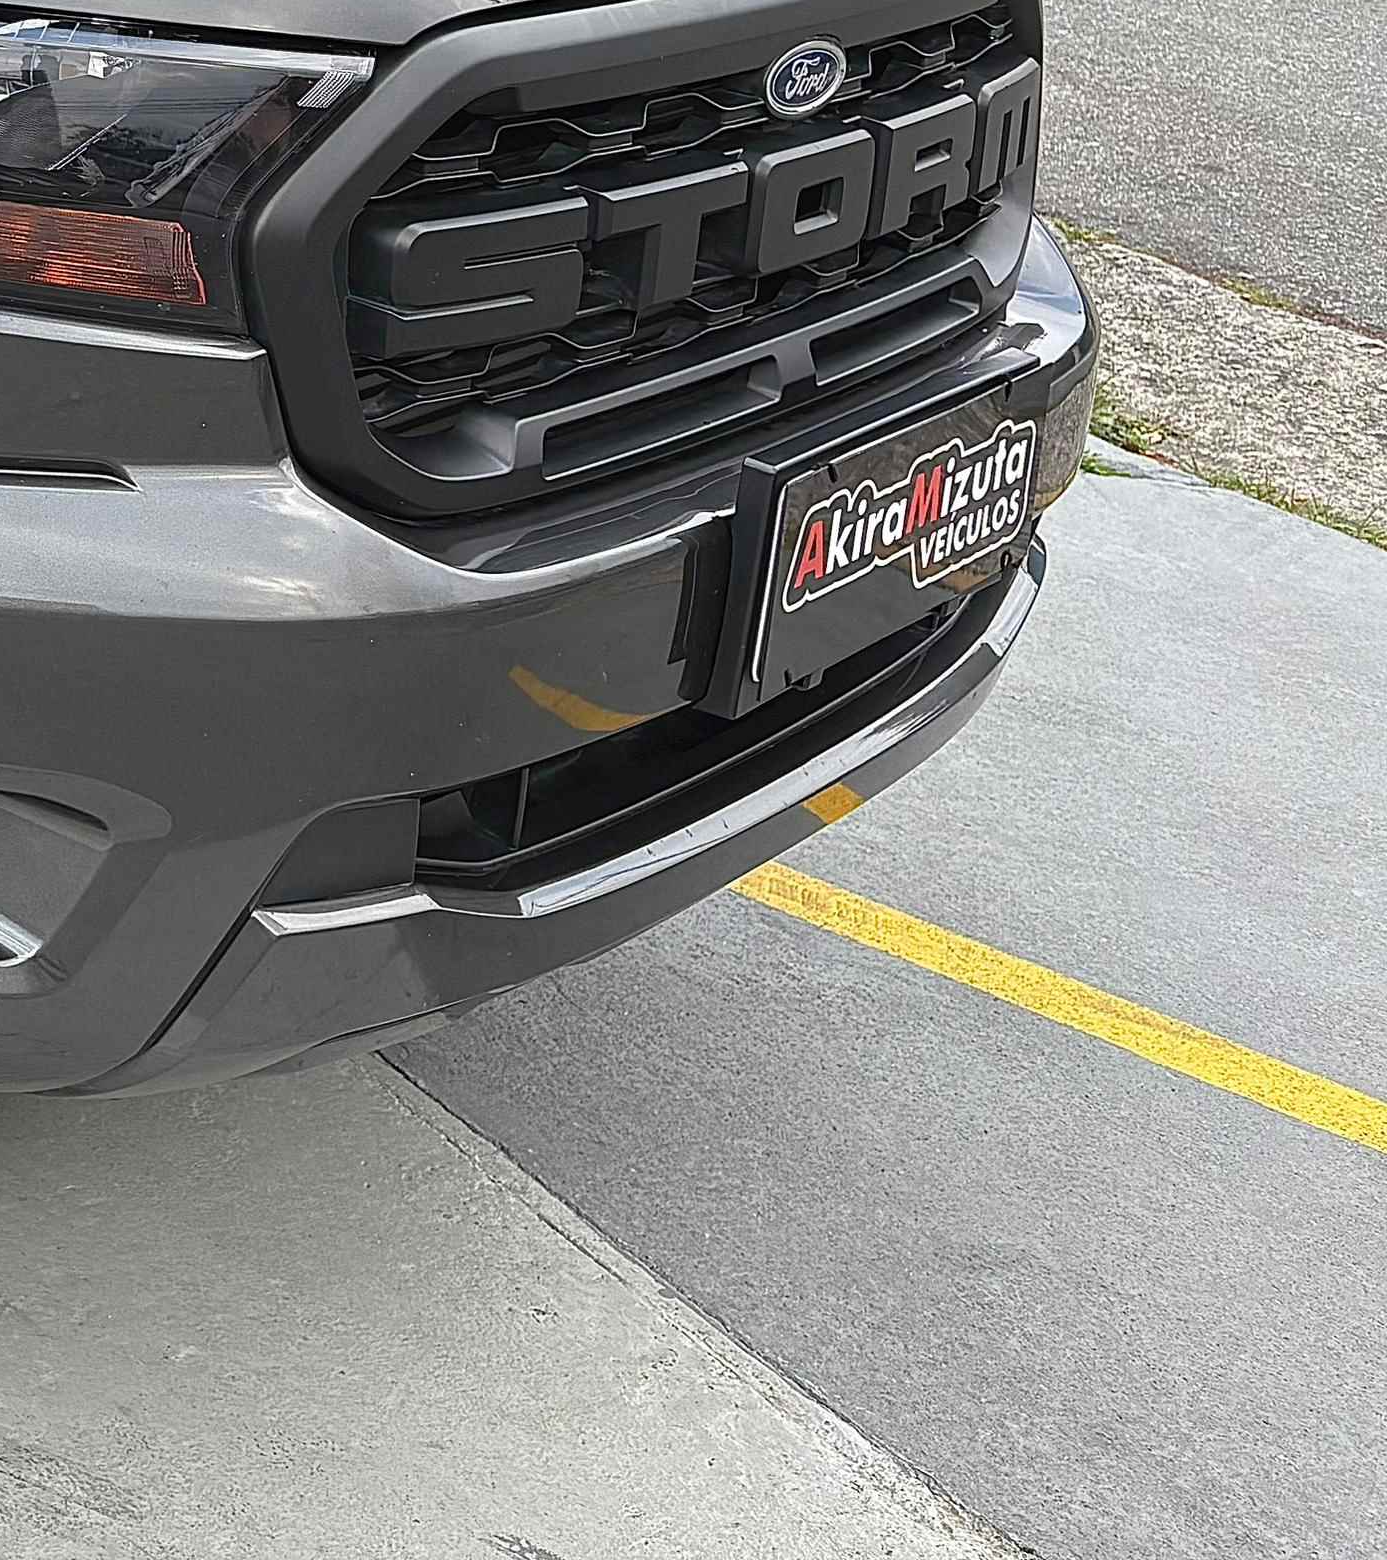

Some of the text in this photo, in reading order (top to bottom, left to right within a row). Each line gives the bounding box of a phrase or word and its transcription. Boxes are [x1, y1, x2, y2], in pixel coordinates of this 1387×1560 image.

[785, 56, 830, 100] Ford
[382, 57, 1039, 360] STORM
[793, 438, 1029, 590] AkiraMizuta
[919, 488, 1021, 570] VEÍCULOS
